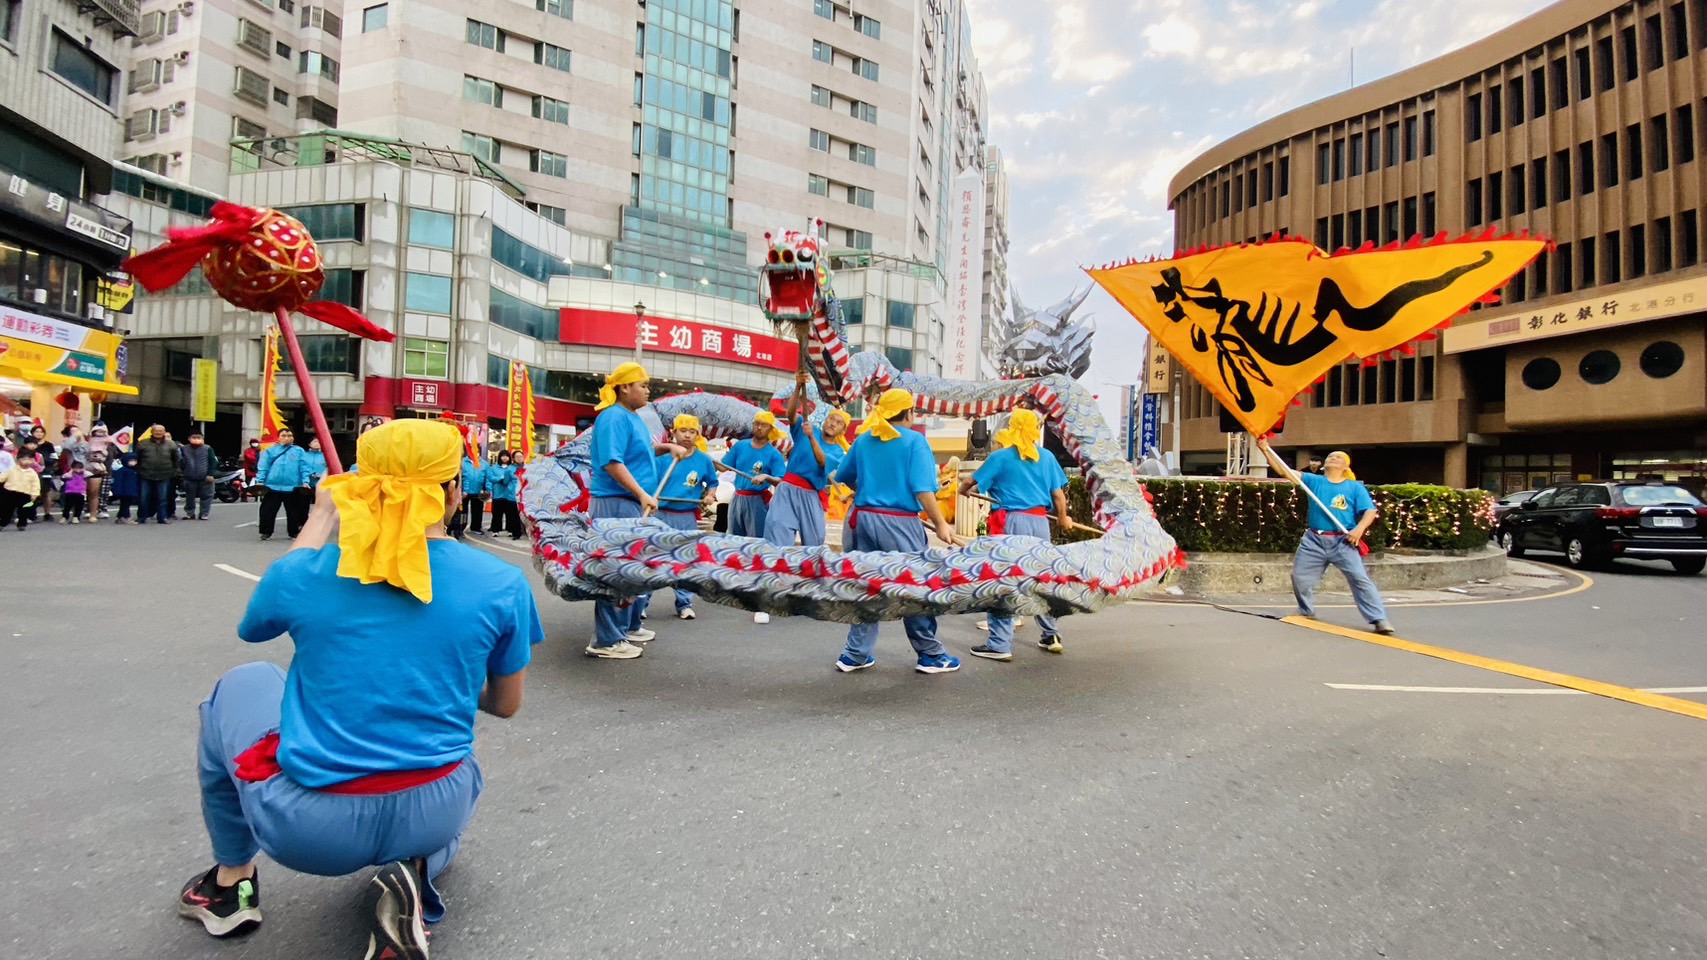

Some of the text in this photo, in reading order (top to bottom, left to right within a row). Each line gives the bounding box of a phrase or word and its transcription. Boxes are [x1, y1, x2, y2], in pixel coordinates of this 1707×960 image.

[1527, 300, 1619, 330] 彰化銀行
[1629, 292, 1695, 313] 北港分行
[635, 320, 752, 358] 主幼商場
